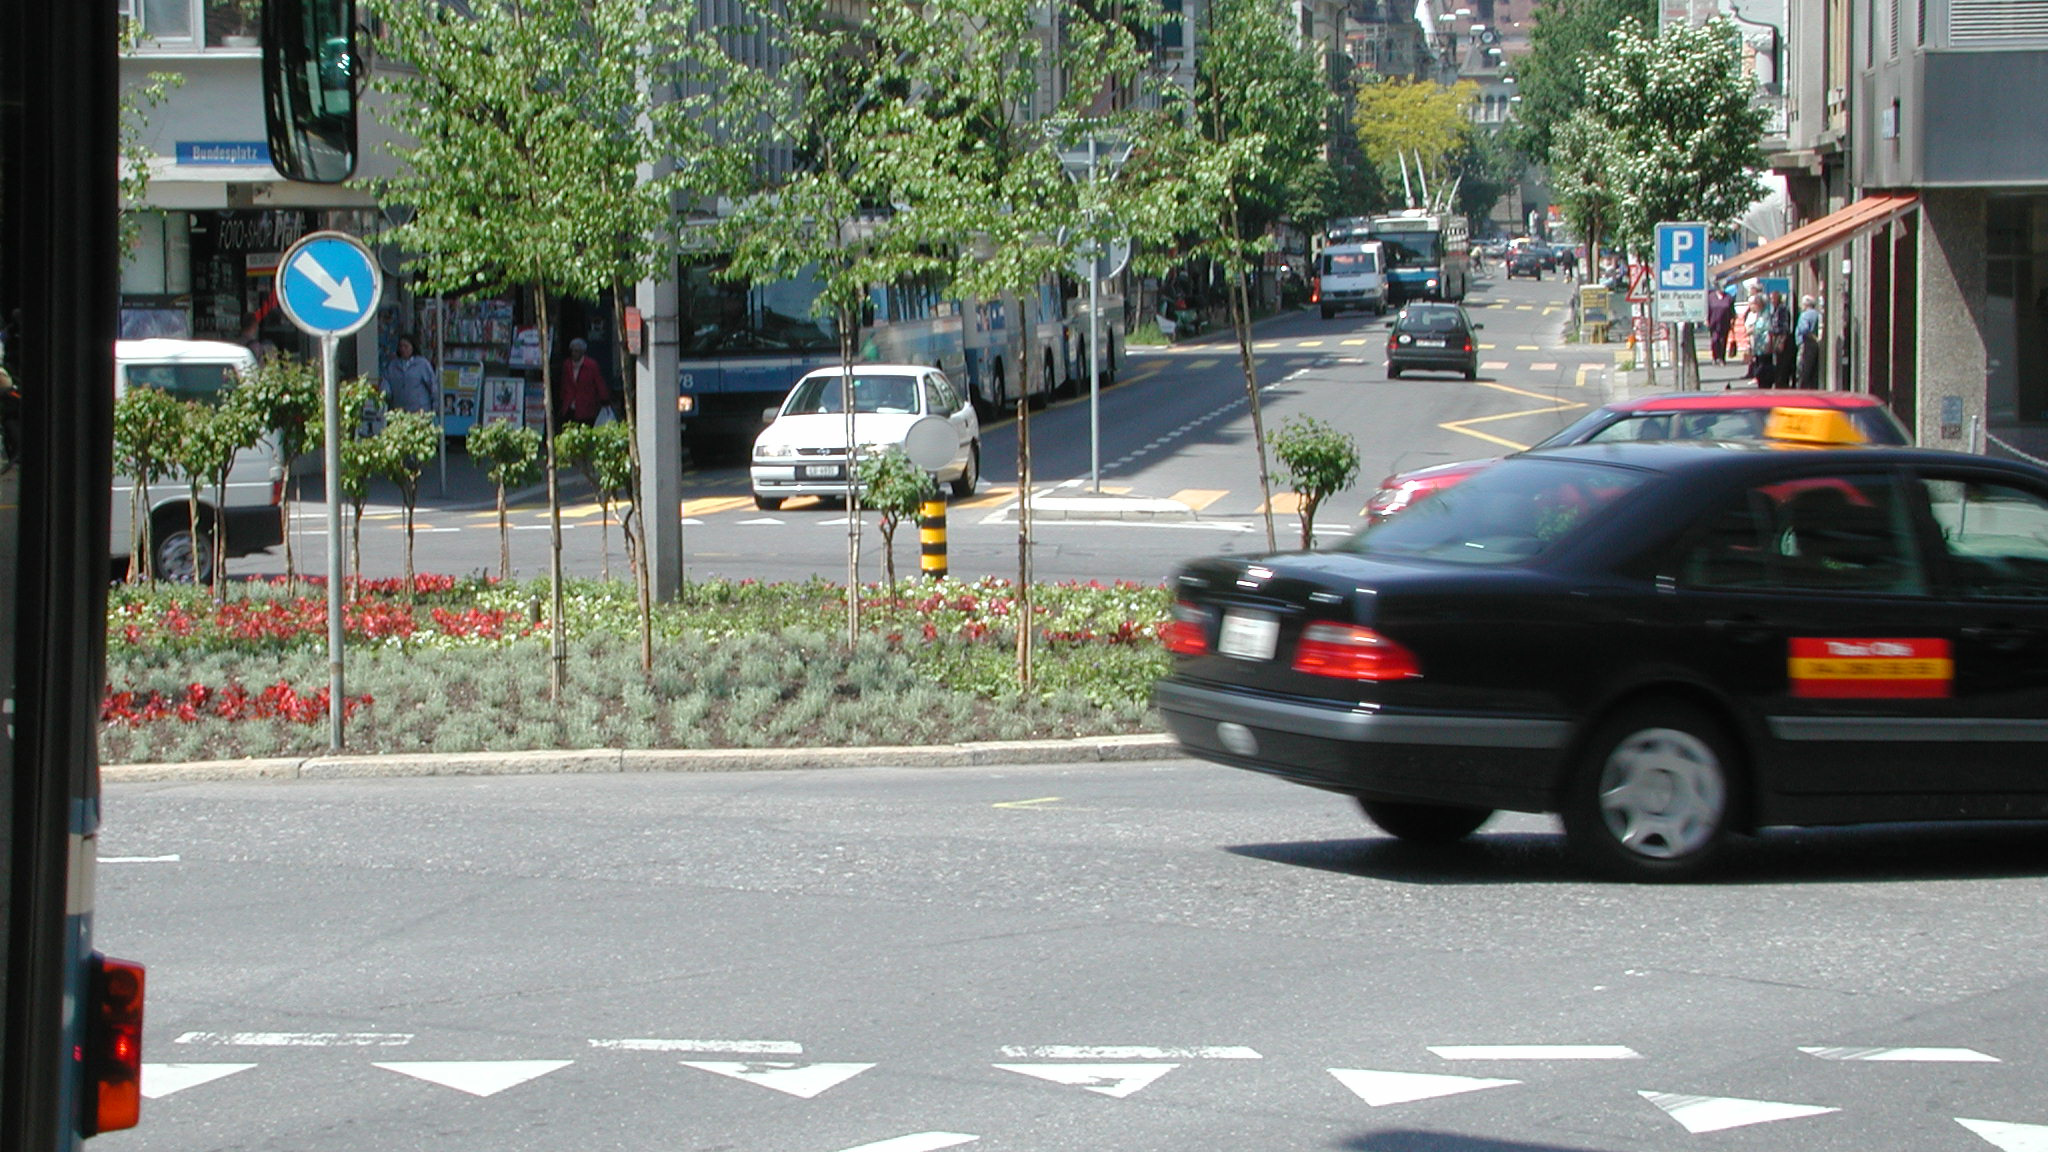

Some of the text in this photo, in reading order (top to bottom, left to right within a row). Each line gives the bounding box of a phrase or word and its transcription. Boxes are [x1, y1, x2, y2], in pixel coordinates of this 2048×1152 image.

[192, 145, 257, 163] Bundesplatz
[1672, 230, 1693, 262] P
[1672, 291, 1703, 300] Parkkarte
